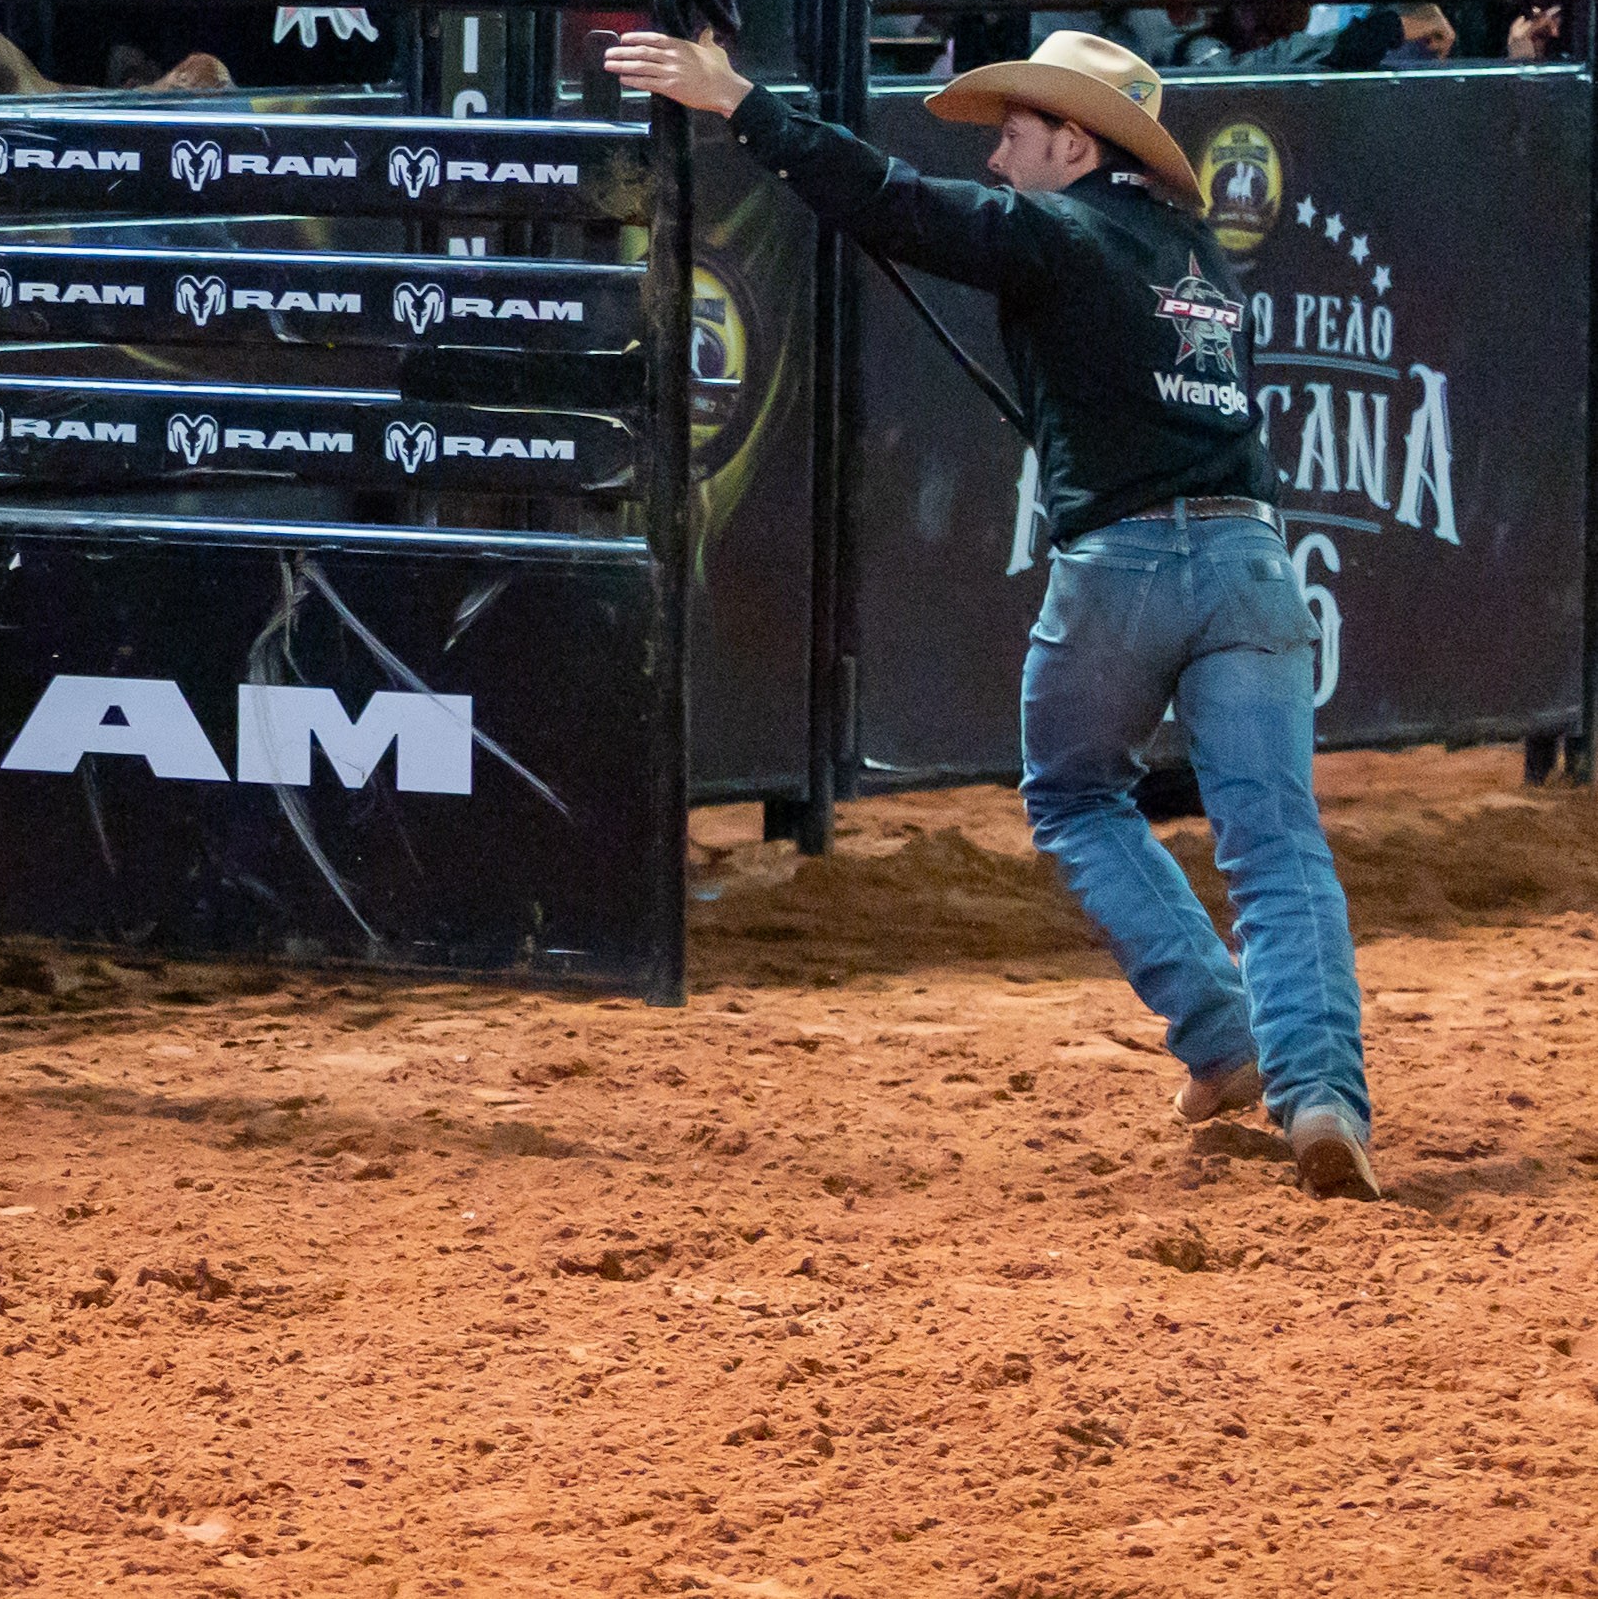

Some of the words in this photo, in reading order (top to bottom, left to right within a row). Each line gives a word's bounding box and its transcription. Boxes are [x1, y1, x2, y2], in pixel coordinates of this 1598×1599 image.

[13, 147, 141, 172] RAM
[228, 152, 357, 177] RAM
[447, 159, 579, 185] RAM
[18, 282, 145, 306] RAM
[232, 288, 362, 314] RAM
[451, 296, 583, 323] RAM
[1161, 298, 1240, 324] PBR
[1295, 295, 1395, 363] PEÃO
[1152, 371, 1250, 418] Wrangle
[10, 418, 137, 443] RAM
[224, 427, 353, 453] RAM
[443, 434, 575, 460] RAM
